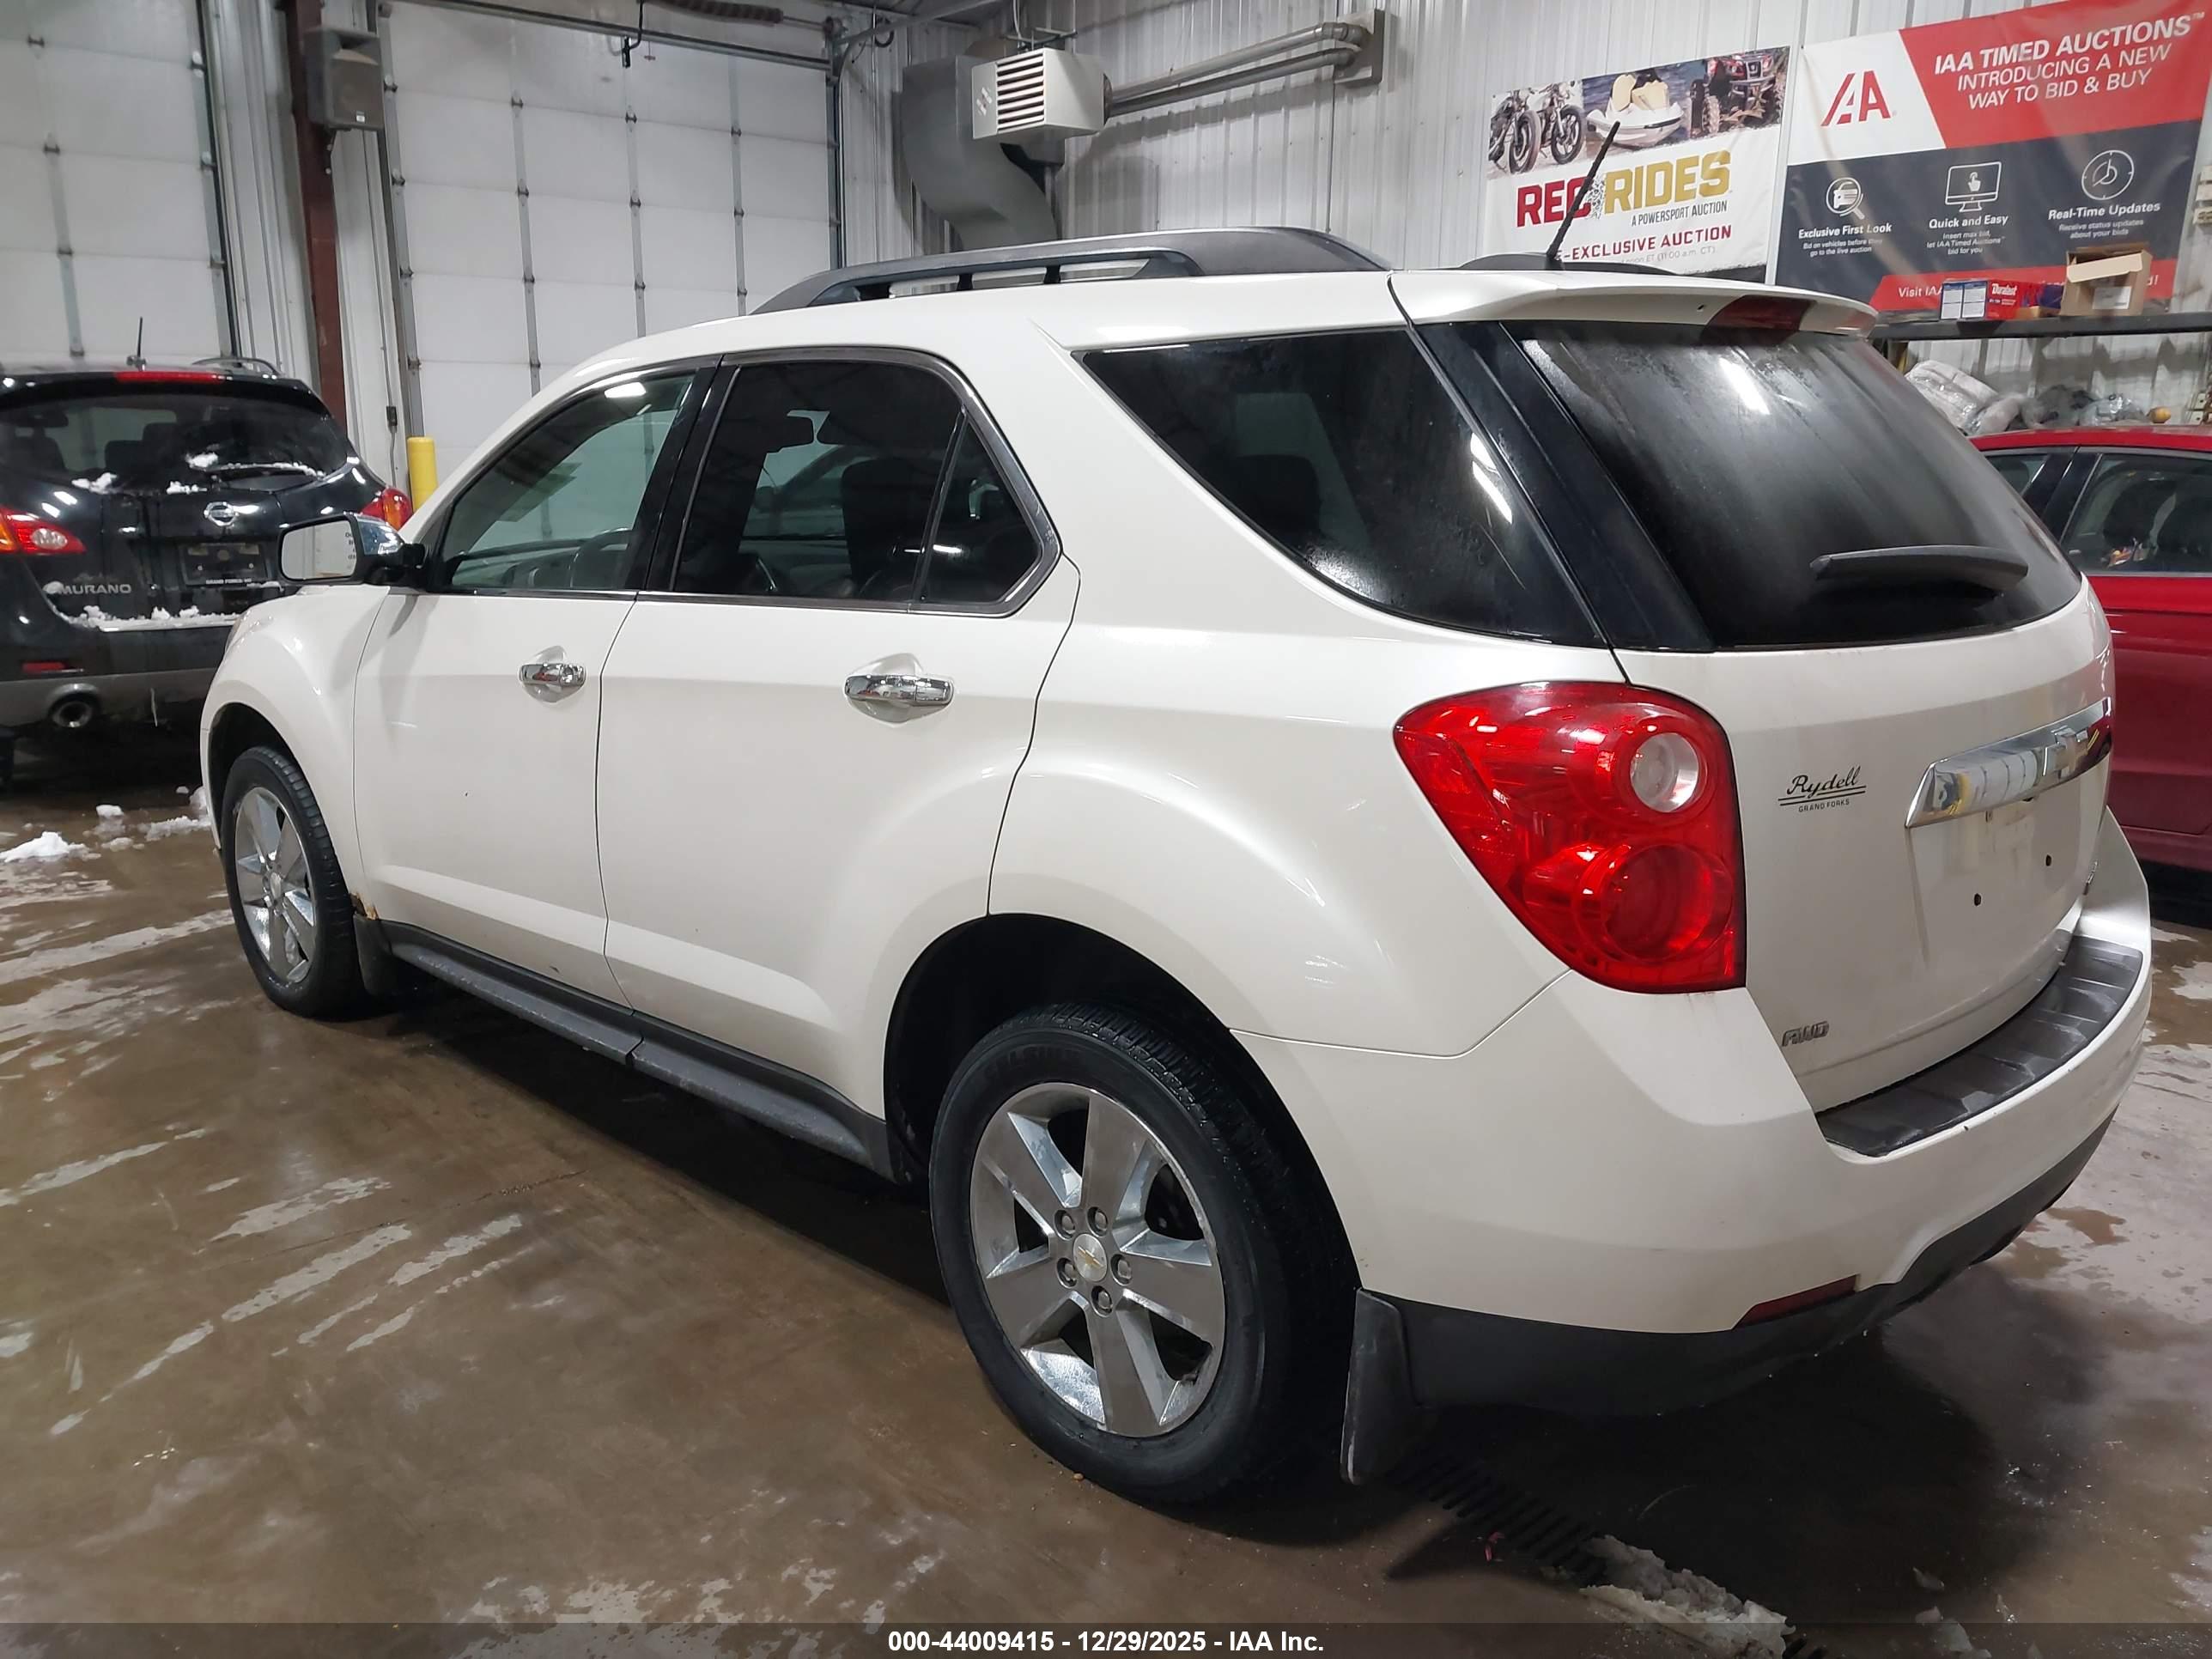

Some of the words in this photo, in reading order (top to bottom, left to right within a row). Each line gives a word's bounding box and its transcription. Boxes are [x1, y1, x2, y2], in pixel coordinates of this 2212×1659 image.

[1935, 52, 1973, 75] IAA
[1979, 40, 2050, 68] TIMED
[1957, 57, 2090, 91] INTRODUCING
[2095, 54, 2112, 70] A
[2119, 43, 2172, 67] NEW
[1969, 88, 2009, 109] WAY
[2015, 84, 2039, 103] TO
[2045, 80, 2078, 99] BID
[2084, 76, 2100, 94] &
[2106, 69, 2152, 91] BUY
[1604, 149, 1731, 214] RIDES
[1632, 216, 1637, 227] A
[1638, 205, 1689, 225] POWERSPORT
[1692, 200, 1728, 216] AUCTION
[1929, 217, 1960, 228] Quick
[1961, 216, 1981, 227] and
[1984, 215, 2008, 226] Easy
[2048, 207, 2105, 220] Real-Time
[2108, 203, 2161, 216] Updates
[1661, 225, 1732, 248] AUCTION
[1798, 227, 1840, 239] Exclusive
[1842, 225, 1863, 234] First
[1866, 222, 1893, 233] Look
[1898, 287, 1922, 297] Visit
[1787, 766, 1861, 799] Rydell
[1798, 802, 1826, 812] GRAND
[1826, 799, 1850, 808] FORKS
[1782, 1021, 1830, 1047] AWD
